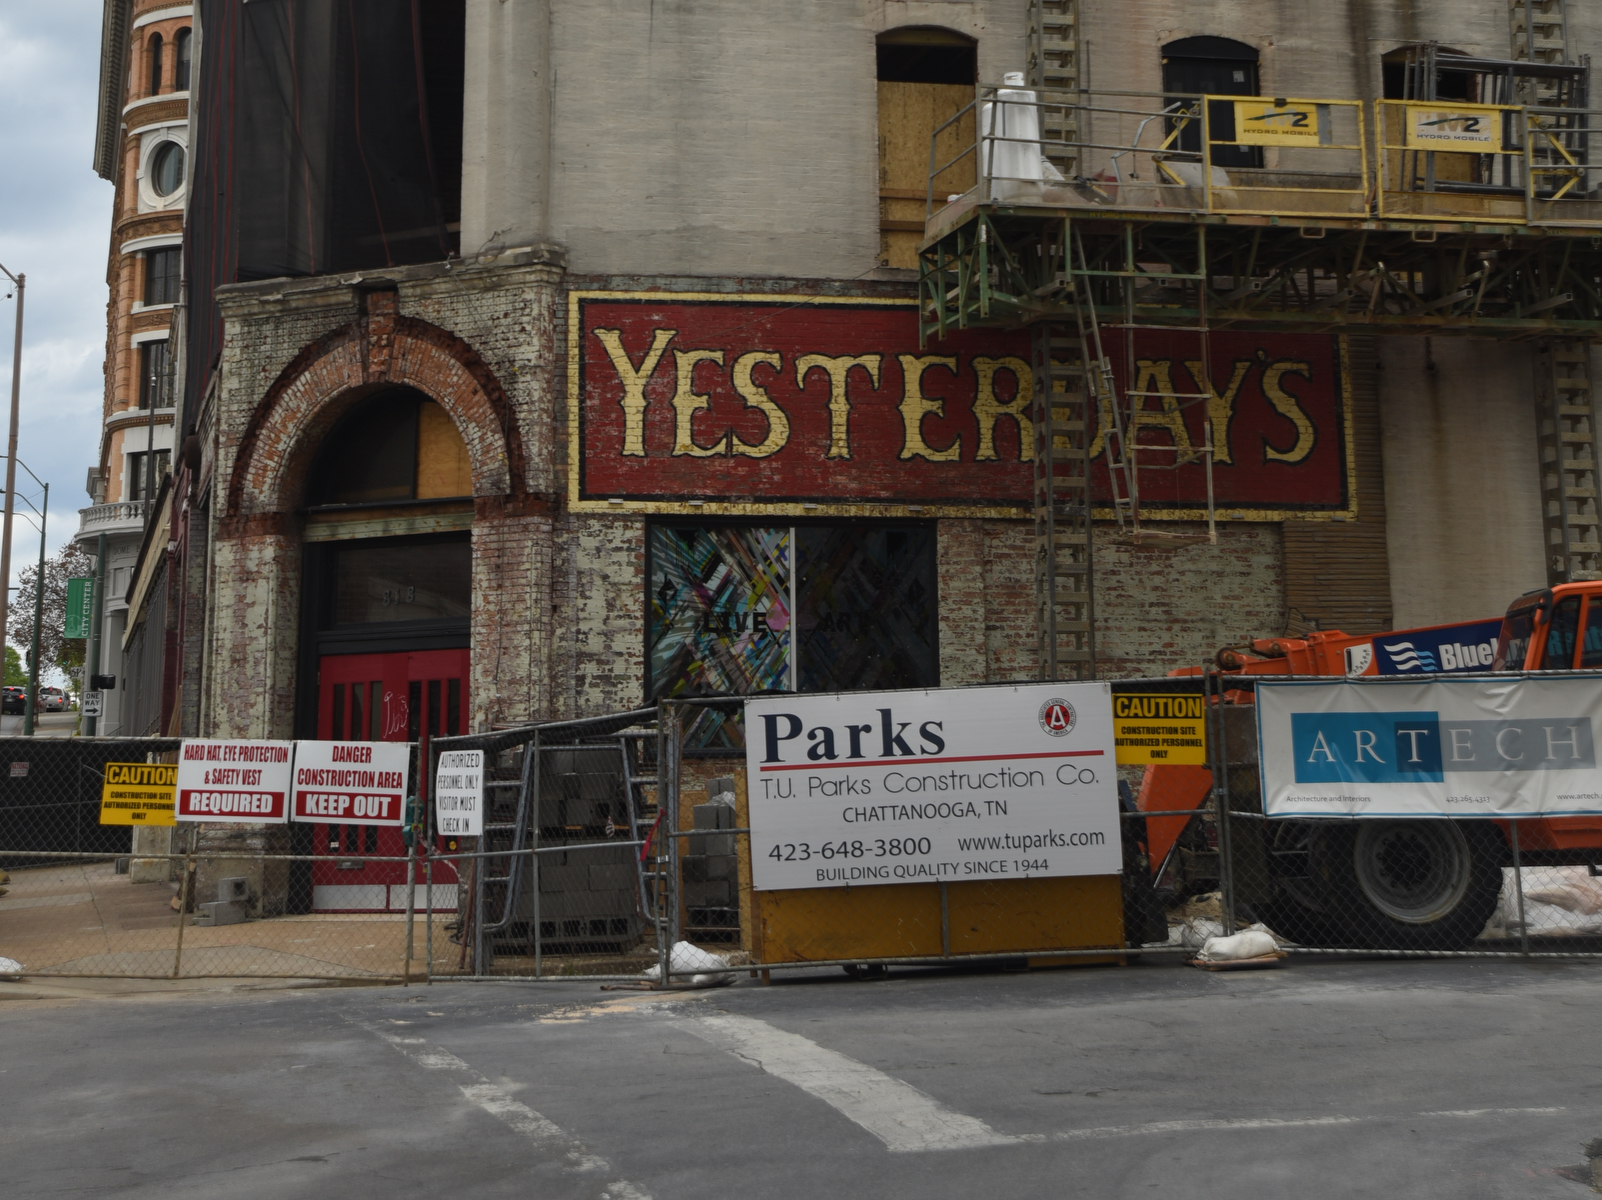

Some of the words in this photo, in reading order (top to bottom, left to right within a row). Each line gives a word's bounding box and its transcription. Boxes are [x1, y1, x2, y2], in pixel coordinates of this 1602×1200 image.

[84, 581, 92, 615] CENTER
[383, 586, 415, 607] 818
[1116, 697, 1201, 717] CAUTION
[758, 708, 945, 763] Parks
[1121, 726, 1178, 735] CONSTRUCTION
[1180, 726, 1196, 735] SITE
[1115, 738, 1160, 746] AUTHORIZED
[1161, 738, 1203, 747] PERSONNEL
[1306, 725, 1580, 764] ARTECH
[184, 744, 205, 761] HARD
[206, 745, 222, 763] HAT,
[223, 745, 239, 761] EYE
[240, 746, 289, 763] PROTECTION
[332, 745, 372, 763] DANGER
[440, 753, 480, 768] AUTHORIZED
[1150, 750, 1168, 759] ONLY
[109, 766, 177, 785] CAUTION
[204, 769, 210, 784] &
[211, 768, 241, 785] SAFETY
[242, 769, 262, 785] VEST
[298, 768, 375, 788] CONSTRUCTION
[376, 771, 403, 789] AREA
[437, 775, 463, 789] PERSONNEL
[465, 775, 479, 790] ONLY
[760, 778, 796, 799] T.U.
[808, 775, 871, 797] Parks
[883, 767, 1044, 793] Construction
[1056, 764, 1099, 785] Co.
[104, 801, 142, 809] AUTHORIZED
[110, 791, 158, 800] CONSTRUCTION
[158, 792, 172, 800] SITE
[189, 792, 273, 813] REQUIRED
[438, 796, 458, 811] VISITOR
[459, 796, 476, 811] MUST
[1445, 795, 1490, 803] 423.265.4313
[305, 794, 350, 815] KEEP
[353, 795, 391, 817] OUT
[843, 802, 981, 823] CHATTANOOGA,
[984, 800, 1008, 816] TN
[131, 812, 147, 820] ONLY
[442, 818, 460, 832] CHECK
[462, 818, 470, 832] IN
[768, 837, 931, 861] 423-648-3800
[958, 828, 1105, 853] www.tuparks.com
[816, 866, 890, 881] BUILDING
[893, 862, 960, 878] QUALITY
[964, 860, 1008, 874] SINCE
[1012, 859, 1049, 872] 1944
